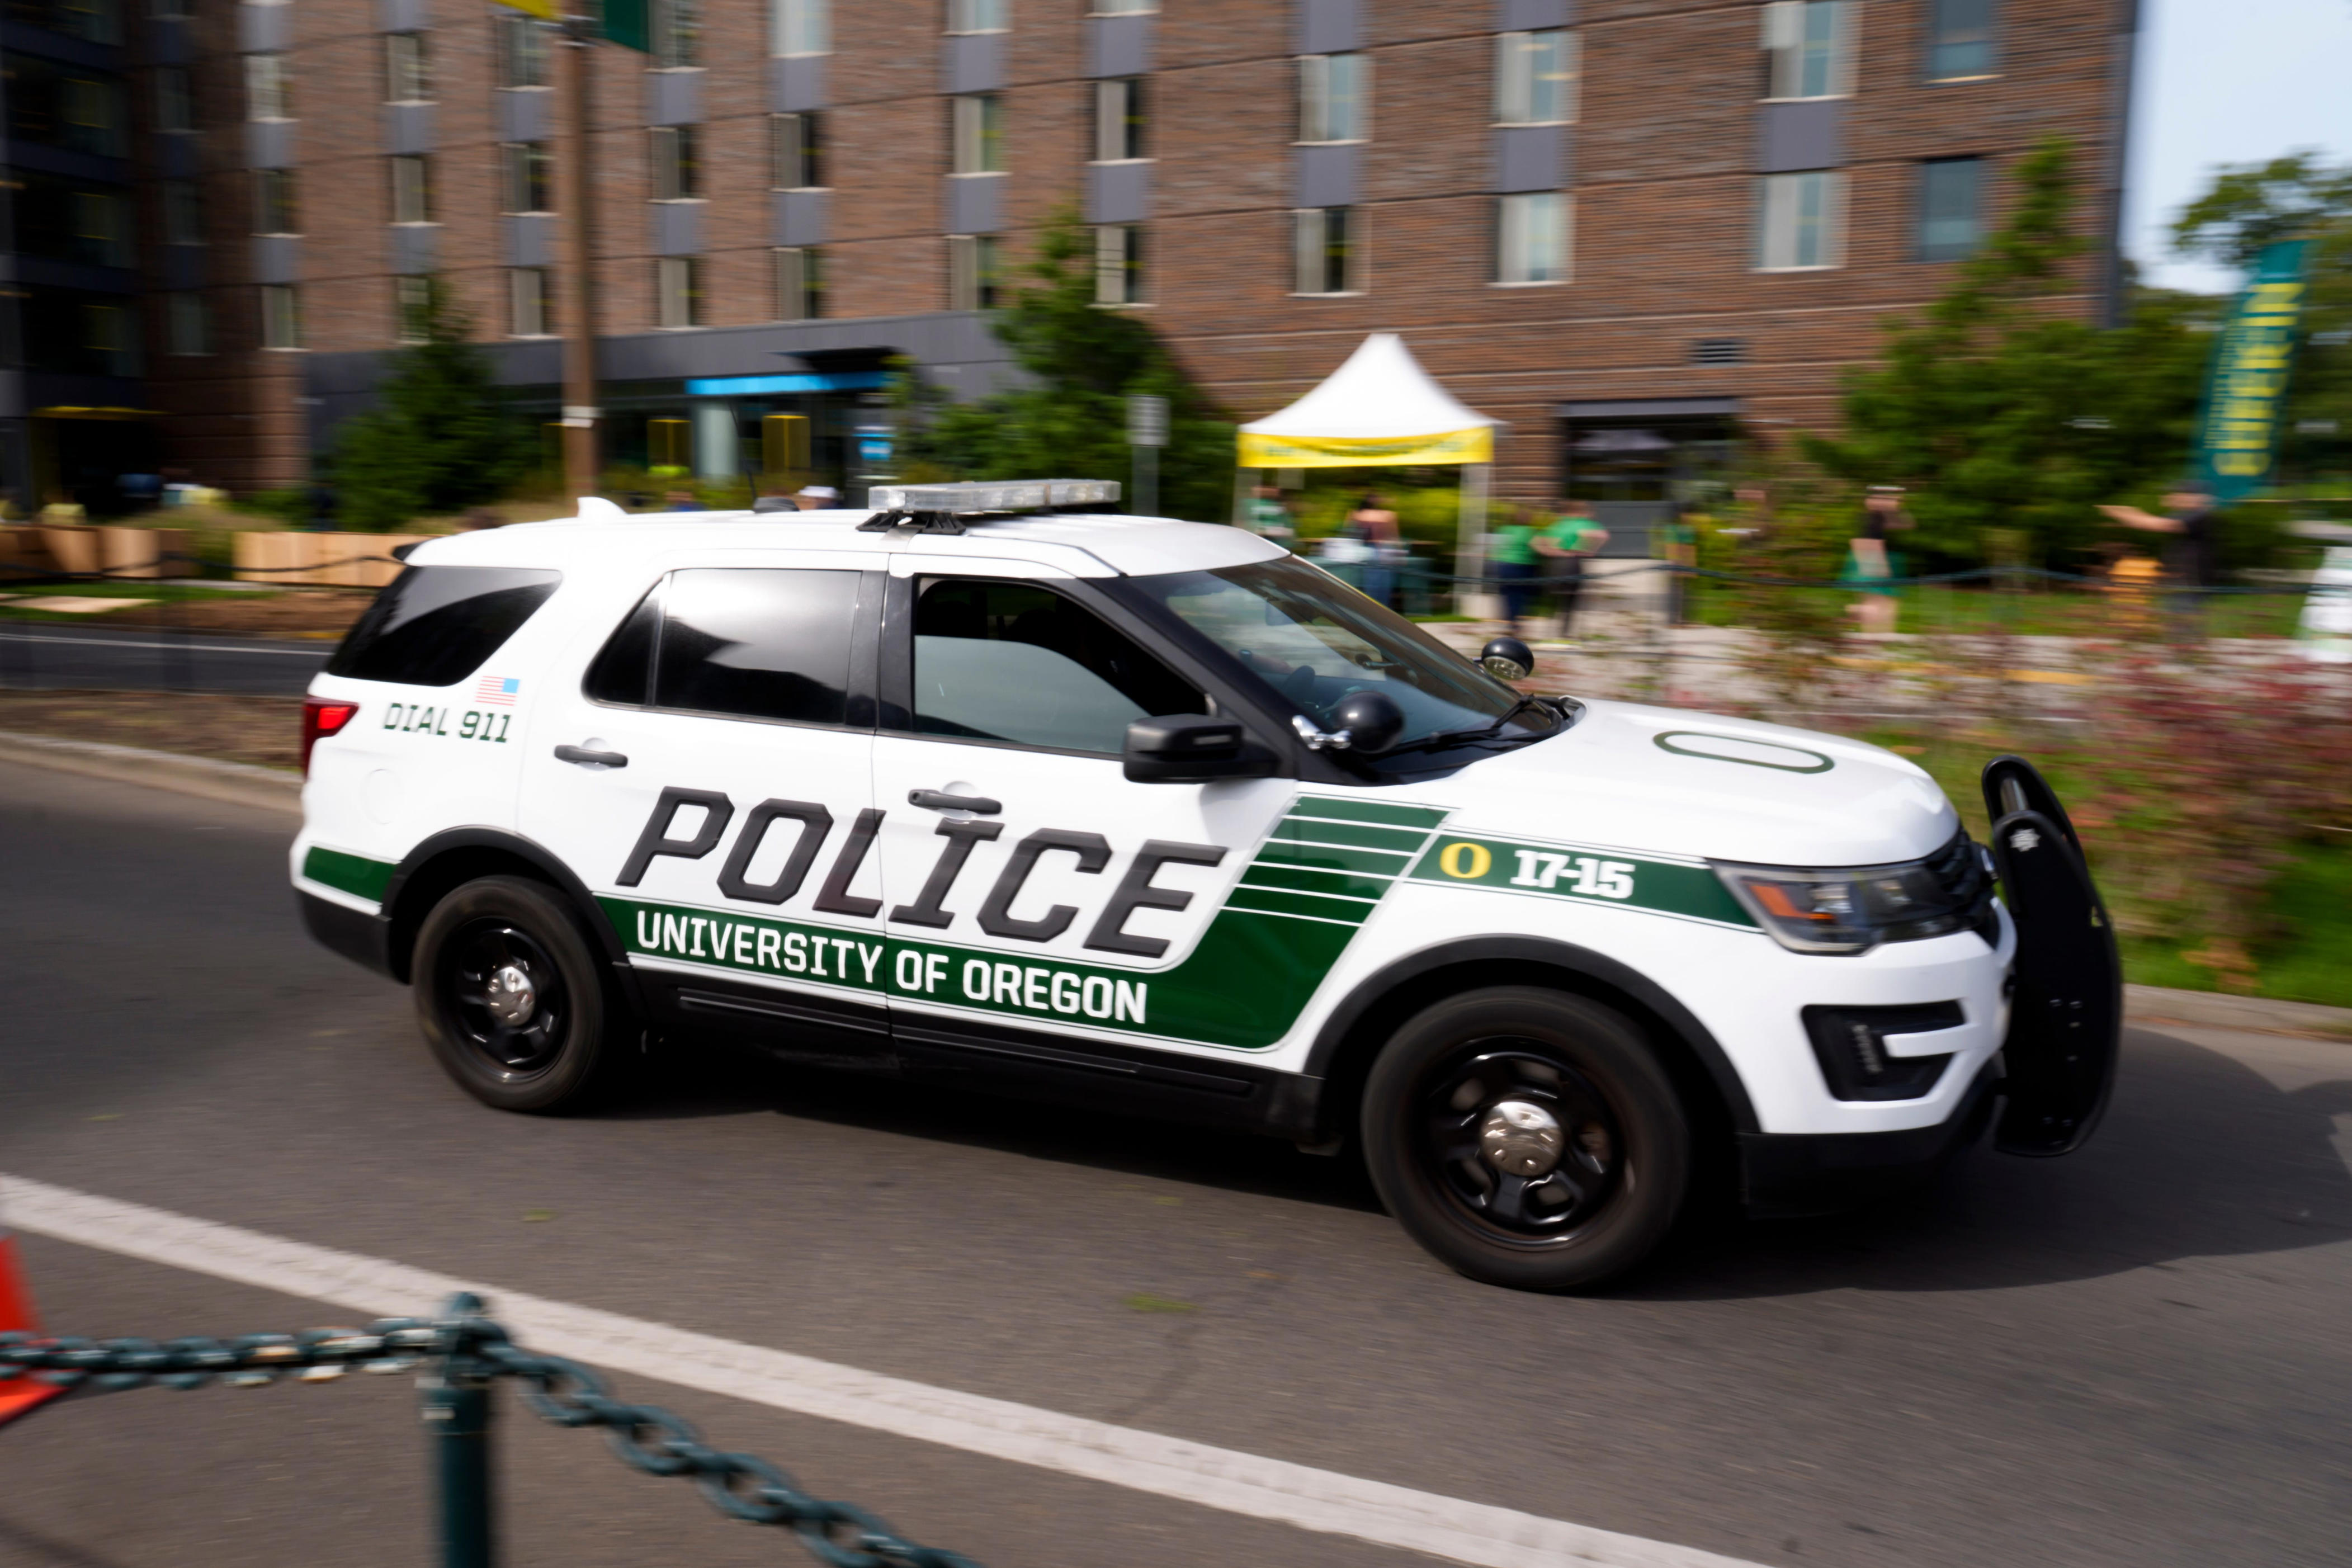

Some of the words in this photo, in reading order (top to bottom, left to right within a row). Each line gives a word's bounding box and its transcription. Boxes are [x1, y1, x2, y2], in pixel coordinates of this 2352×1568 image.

[382, 702, 448, 736] DIAL
[459, 710, 511, 743] 911
[615, 785, 1230, 959] POLICE
[1439, 842, 1492, 879] O
[1509, 849, 1636, 900] 17-15
[636, 909, 885, 984] UNIVERSITY
[895, 949, 950, 994] OF
[962, 958, 1148, 1024] OREGON
